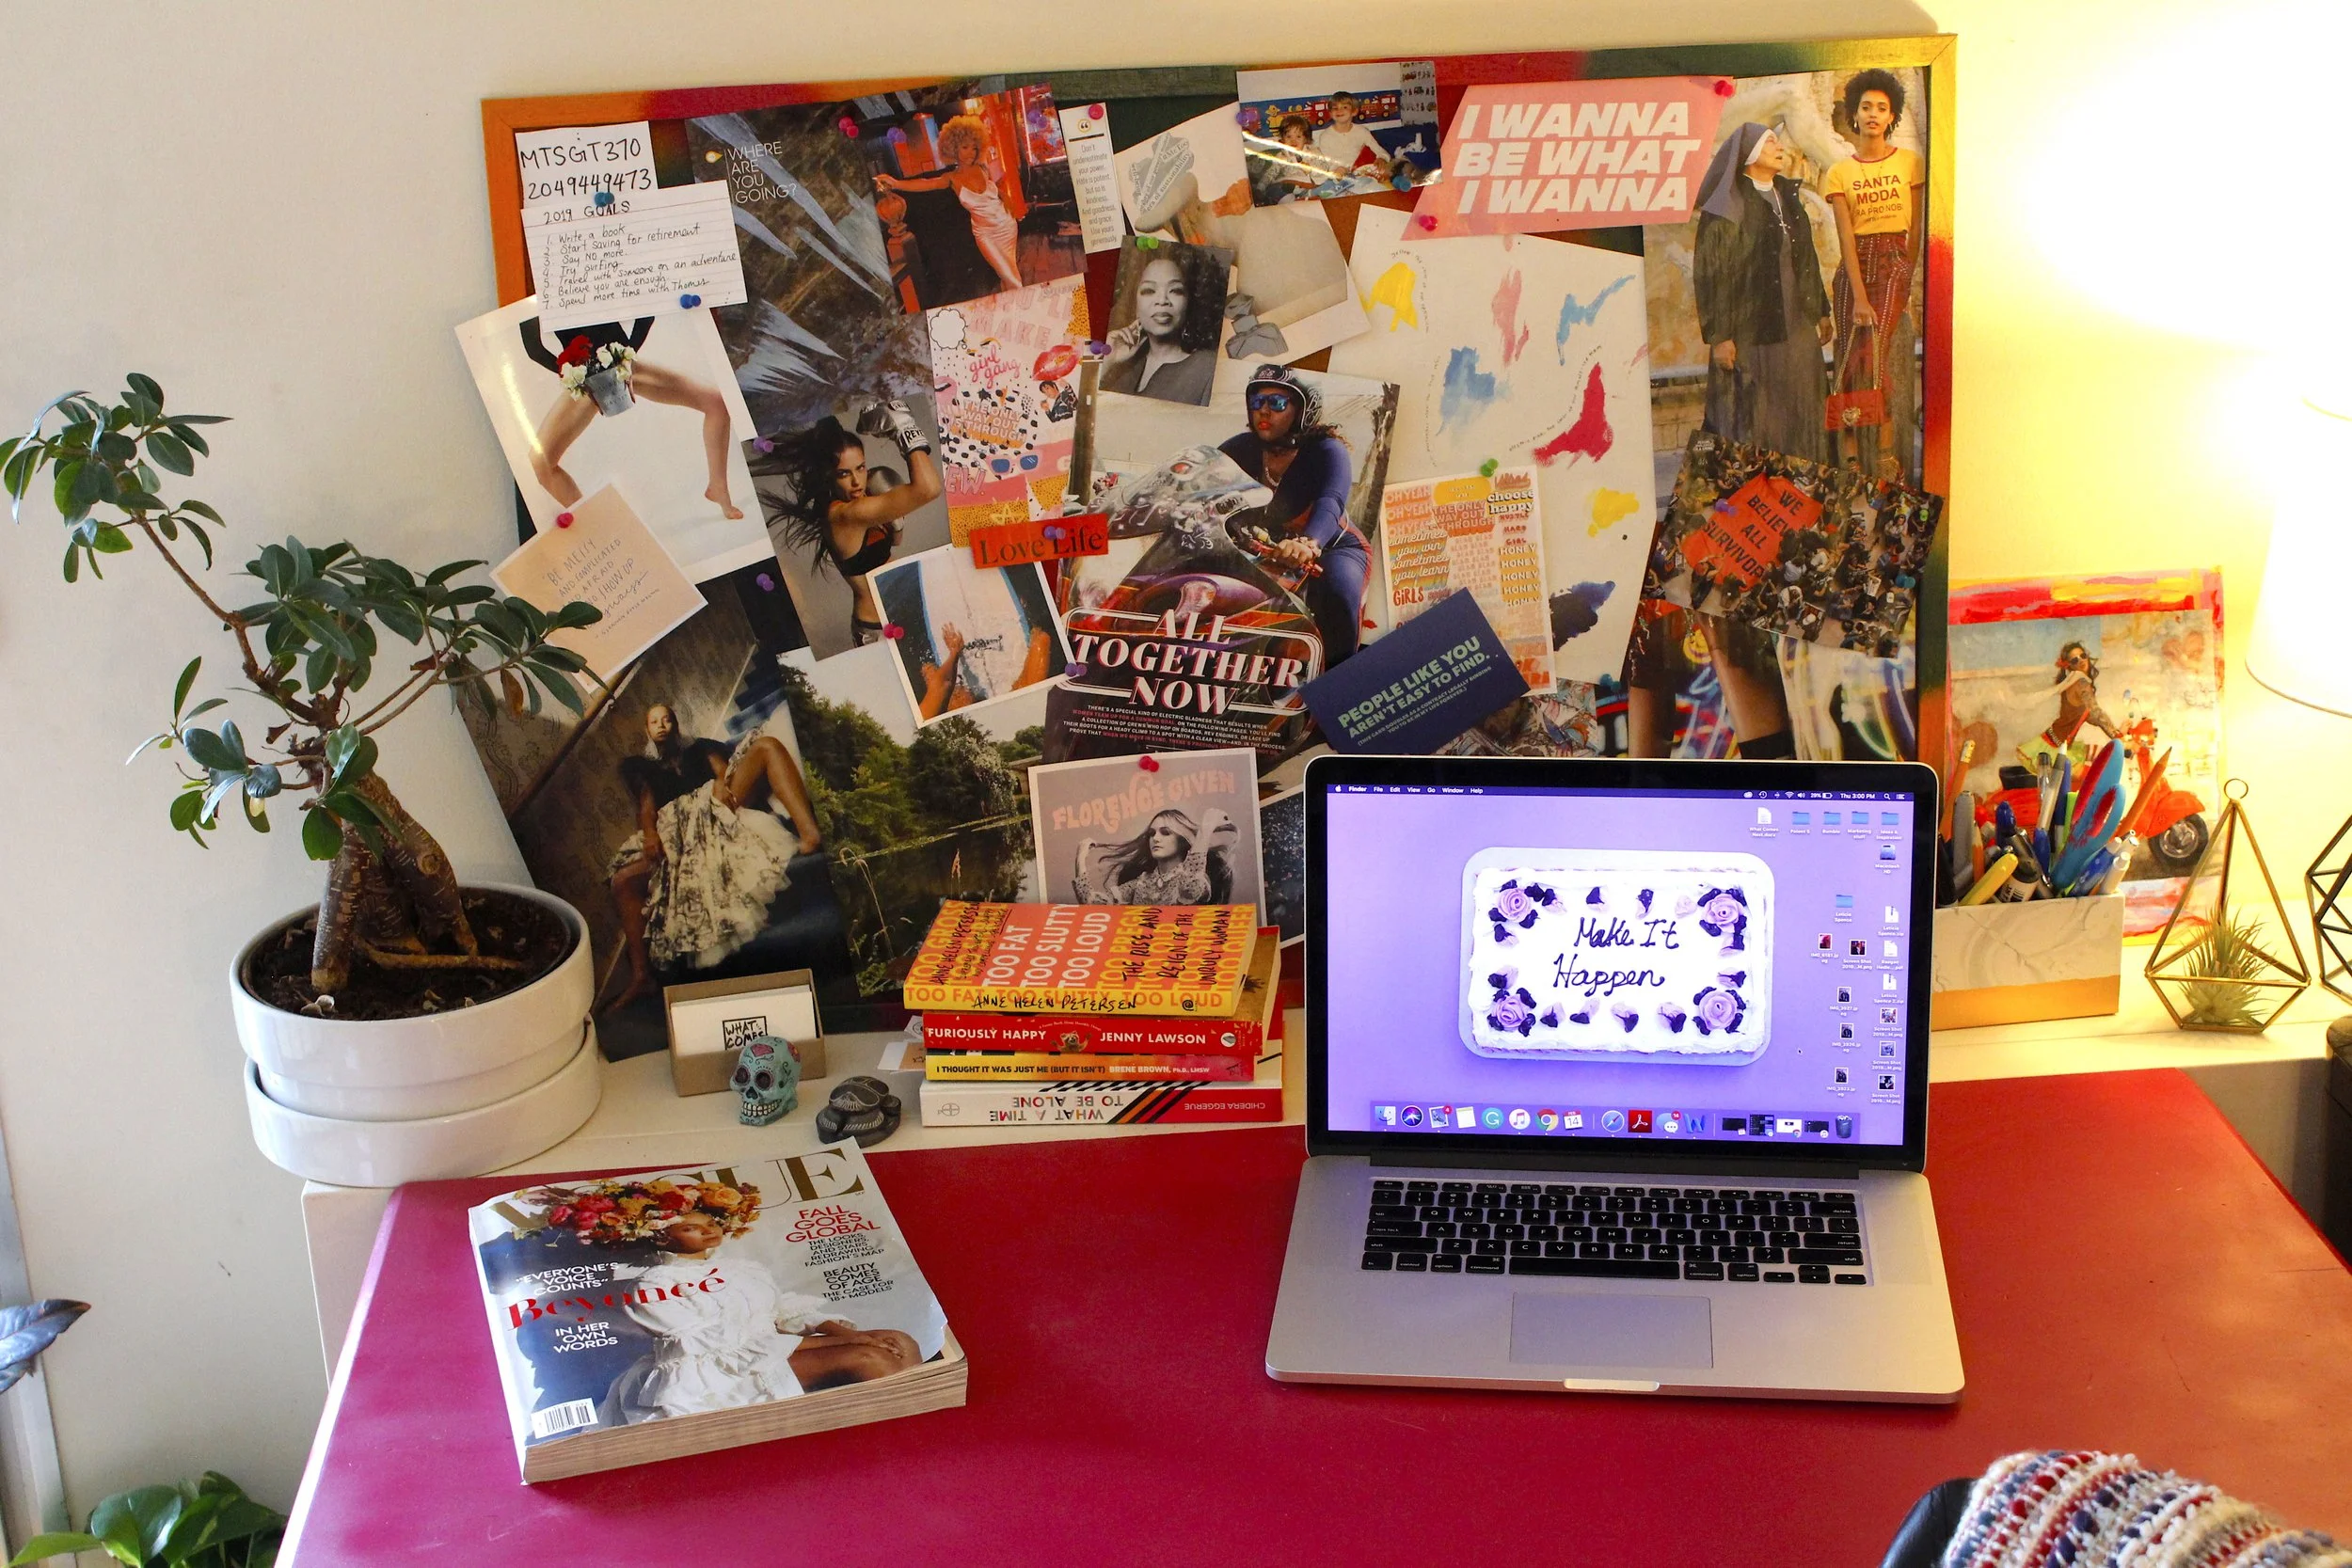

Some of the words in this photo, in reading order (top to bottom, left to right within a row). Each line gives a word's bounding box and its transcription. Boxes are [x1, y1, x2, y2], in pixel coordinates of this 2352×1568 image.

[1458, 104, 1480, 139] I
[1487, 102, 1689, 139] WANNA
[520, 138, 641, 169] MTSGT370
[727, 141, 783, 161] WHERE
[1453, 141, 1531, 178] BE
[1537, 138, 1702, 176] WHAT
[731, 159, 759, 175] ARE
[528, 168, 652, 200] 2049449473
[732, 173, 764, 189] YOU
[1852, 175, 1900, 190] SANTA
[735, 182, 797, 204] GOING?
[1458, 178, 1480, 214] I
[1486, 176, 1688, 214] WANNA
[1856, 187, 1899, 205] MODA
[544, 209, 573, 224] 2019
[583, 201, 630, 217] GOALS
[559, 231, 582, 244] Write
[602, 225, 626, 238] book
[560, 241, 587, 255] Start
[592, 238, 621, 253] saving
[628, 232, 643, 245] for
[647, 223, 700, 241] retirement
[559, 276, 588, 286] Travel
[594, 270, 612, 281] with
[618, 266, 653, 277] someone
[691, 252, 737, 266] adventure
[563, 255, 580, 267] Say
[585, 253, 597, 261] NO
[561, 265, 576, 277] Try
[558, 284, 589, 297] Believe
[594, 285, 610, 293] you
[559, 295, 586, 309] Spend
[593, 293, 614, 302] more
[621, 288, 641, 298] time
[647, 284, 670, 294] with
[1486, 489, 1534, 504] choose
[1778, 489, 1804, 516] WE
[1488, 501, 1534, 515] happy
[1746, 494, 1789, 537] BELIEV
[979, 537, 1046, 565] Love
[1053, 524, 1105, 554] Life
[1741, 523, 1768, 550] ALL
[1499, 544, 1536, 556] HONEY
[1702, 519, 1765, 578] SURVIVOR
[1500, 557, 1537, 569] HONEY
[1501, 570, 1538, 582] HONEY
[1152, 609, 1230, 644] ALL
[1073, 633, 1304, 689] TOGETHER
[1338, 683, 1405, 728] PEOPLE
[1403, 659, 1442, 690] LIKE
[1440, 636, 1481, 666] YOU
[1129, 675, 1239, 715] NOW
[1349, 704, 1395, 738] AREN’T
[1397, 683, 1431, 709] EASY
[1431, 673, 1452, 689] TO
[1452, 652, 1490, 677] FIND.
[1053, 770, 1166, 834] FLORENCE
[1168, 768, 1235, 801] GIVEN
[1139, 908, 1163, 929] AND
[998, 925, 1034, 951] FAT
[1036, 904, 1080, 953] SLUTTY
[1072, 912, 1111, 953] LOUD
[1573, 917, 1635, 951] Make
[1640, 918, 1680, 950] It
[1130, 934, 1154, 957] RISE
[982, 955, 1021, 988] TOO
[1019, 956, 1057, 988] TOO
[1057, 956, 1096, 989] TOO
[1552, 952, 1665, 997] Happen
[906, 987, 946, 1002] TOO
[996, 990, 1037, 1004] TOO
[1122, 991, 1163, 1006] TOO
[1170, 992, 1222, 1007] LOUD
[972, 994, 1009, 1009] ANNE
[1014, 995, 1055, 1008] HELEN
[1061, 993, 1137, 1013] PETERSEN
[725, 1020, 756, 1036] WHAT
[928, 1027, 998, 1039] FURIOUSLY
[1003, 1029, 1047, 1040] HAPPY
[1100, 1033, 1143, 1043] JENNY
[1148, 1034, 1206, 1044] LAWSON
[1051, 1066, 1070, 1074] (BUT
[1137, 1066, 1171, 1074] BROWN,
[1013, 1096, 1066, 1108] ALONE
[1077, 1095, 1094, 1107] BE
[1102, 1095, 1124, 1107] TO
[990, 1110, 1026, 1122] TIME
[1036, 1109, 1046, 1121] A
[1056, 1109, 1104, 1121] WHAT
[794, 1212, 863, 1230] GOES
[798, 1205, 850, 1220] FALL
[786, 1220, 881, 1243] GLOBAL
[808, 1238, 826, 1246] THE
[810, 1237, 869, 1251] DESIGNERS,
[813, 1247, 835, 1256] AND
[837, 1243, 867, 1251] STARS
[810, 1245, 874, 1261] REDRAWING
[861, 1248, 884, 1258] MAP
[823, 1262, 875, 1277] BEAUTY
[825, 1268, 880, 1284] COMES
[543, 1272, 596, 1287] VOICE
[829, 1282, 849, 1291] OF
[852, 1275, 882, 1287] AGE
[822, 1290, 842, 1299] THE
[843, 1285, 869, 1294] CASE
[872, 1280, 894, 1289] FOR
[830, 1294, 846, 1303] 18+
[849, 1286, 893, 1299] MODELS
[502, 1268, 726, 1332] Beyoncé
[555, 1326, 573, 1338] IN
[578, 1321, 610, 1334] HER
[562, 1330, 607, 1343] OWN
[553, 1337, 619, 1354] WORDS
